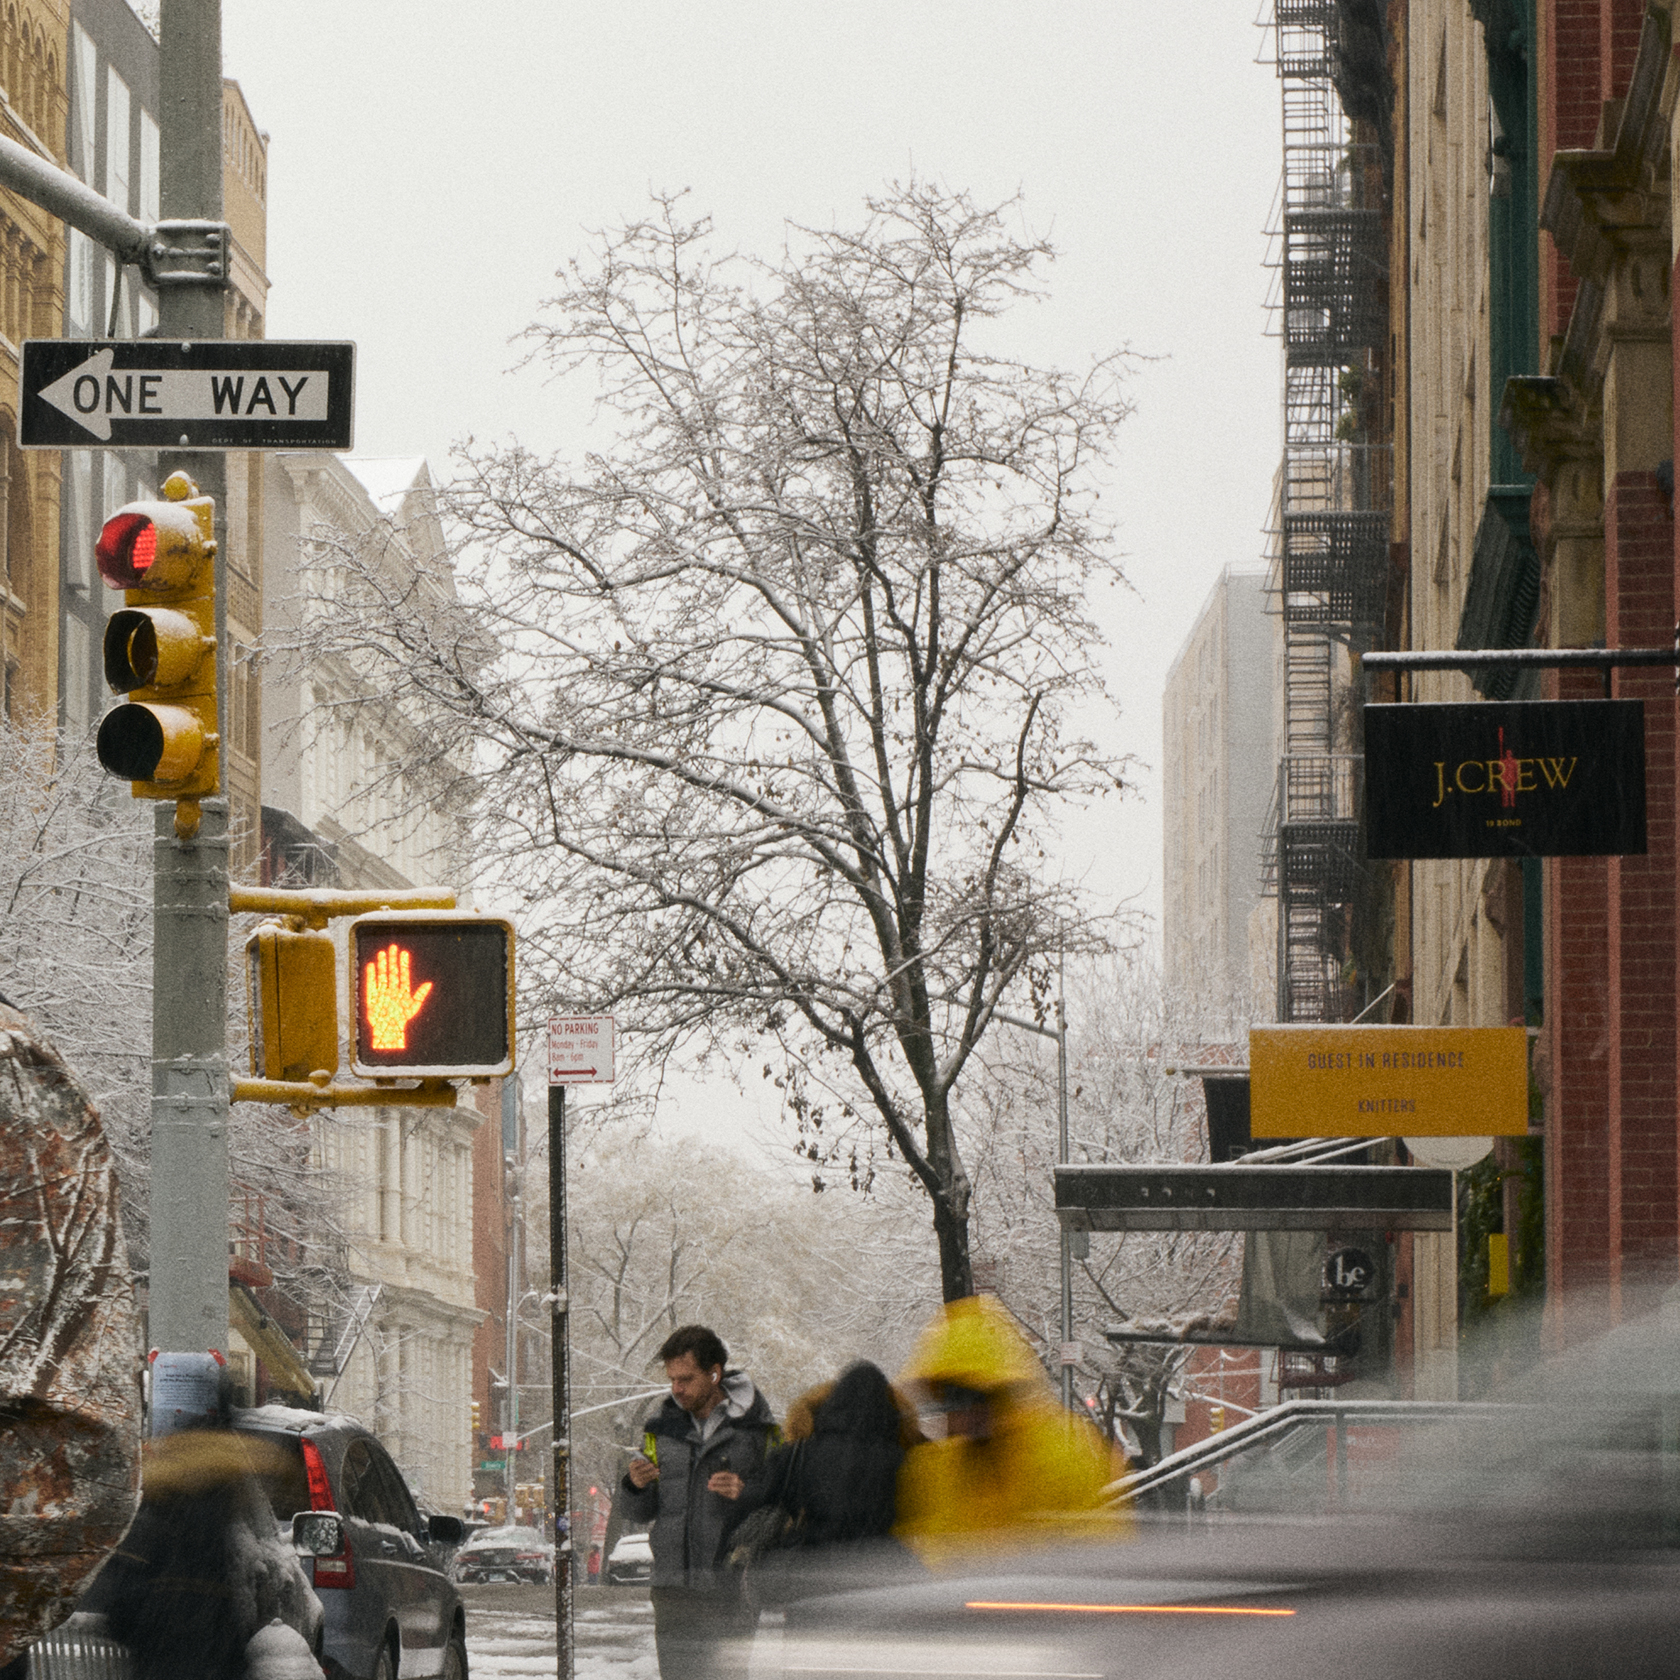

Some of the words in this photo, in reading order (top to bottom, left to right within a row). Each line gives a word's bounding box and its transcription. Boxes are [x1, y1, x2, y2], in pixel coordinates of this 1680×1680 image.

[73, 374, 163, 414] ONE
[211, 376, 310, 415] WAY
[1432, 756, 1578, 808] J.CREW
[1496, 818, 1522, 827] BOND
[551, 1023, 563, 1035] NO
[564, 1022, 599, 1034] PARKING
[551, 1040, 575, 1050] Monday
[580, 1039, 599, 1050] Friday
[1308, 1053, 1352, 1070] GUEST
[1358, 1052, 1376, 1069] IN
[1382, 1051, 1465, 1069] RESIDENCE
[1357, 1099, 1416, 1113] KNITTERS
